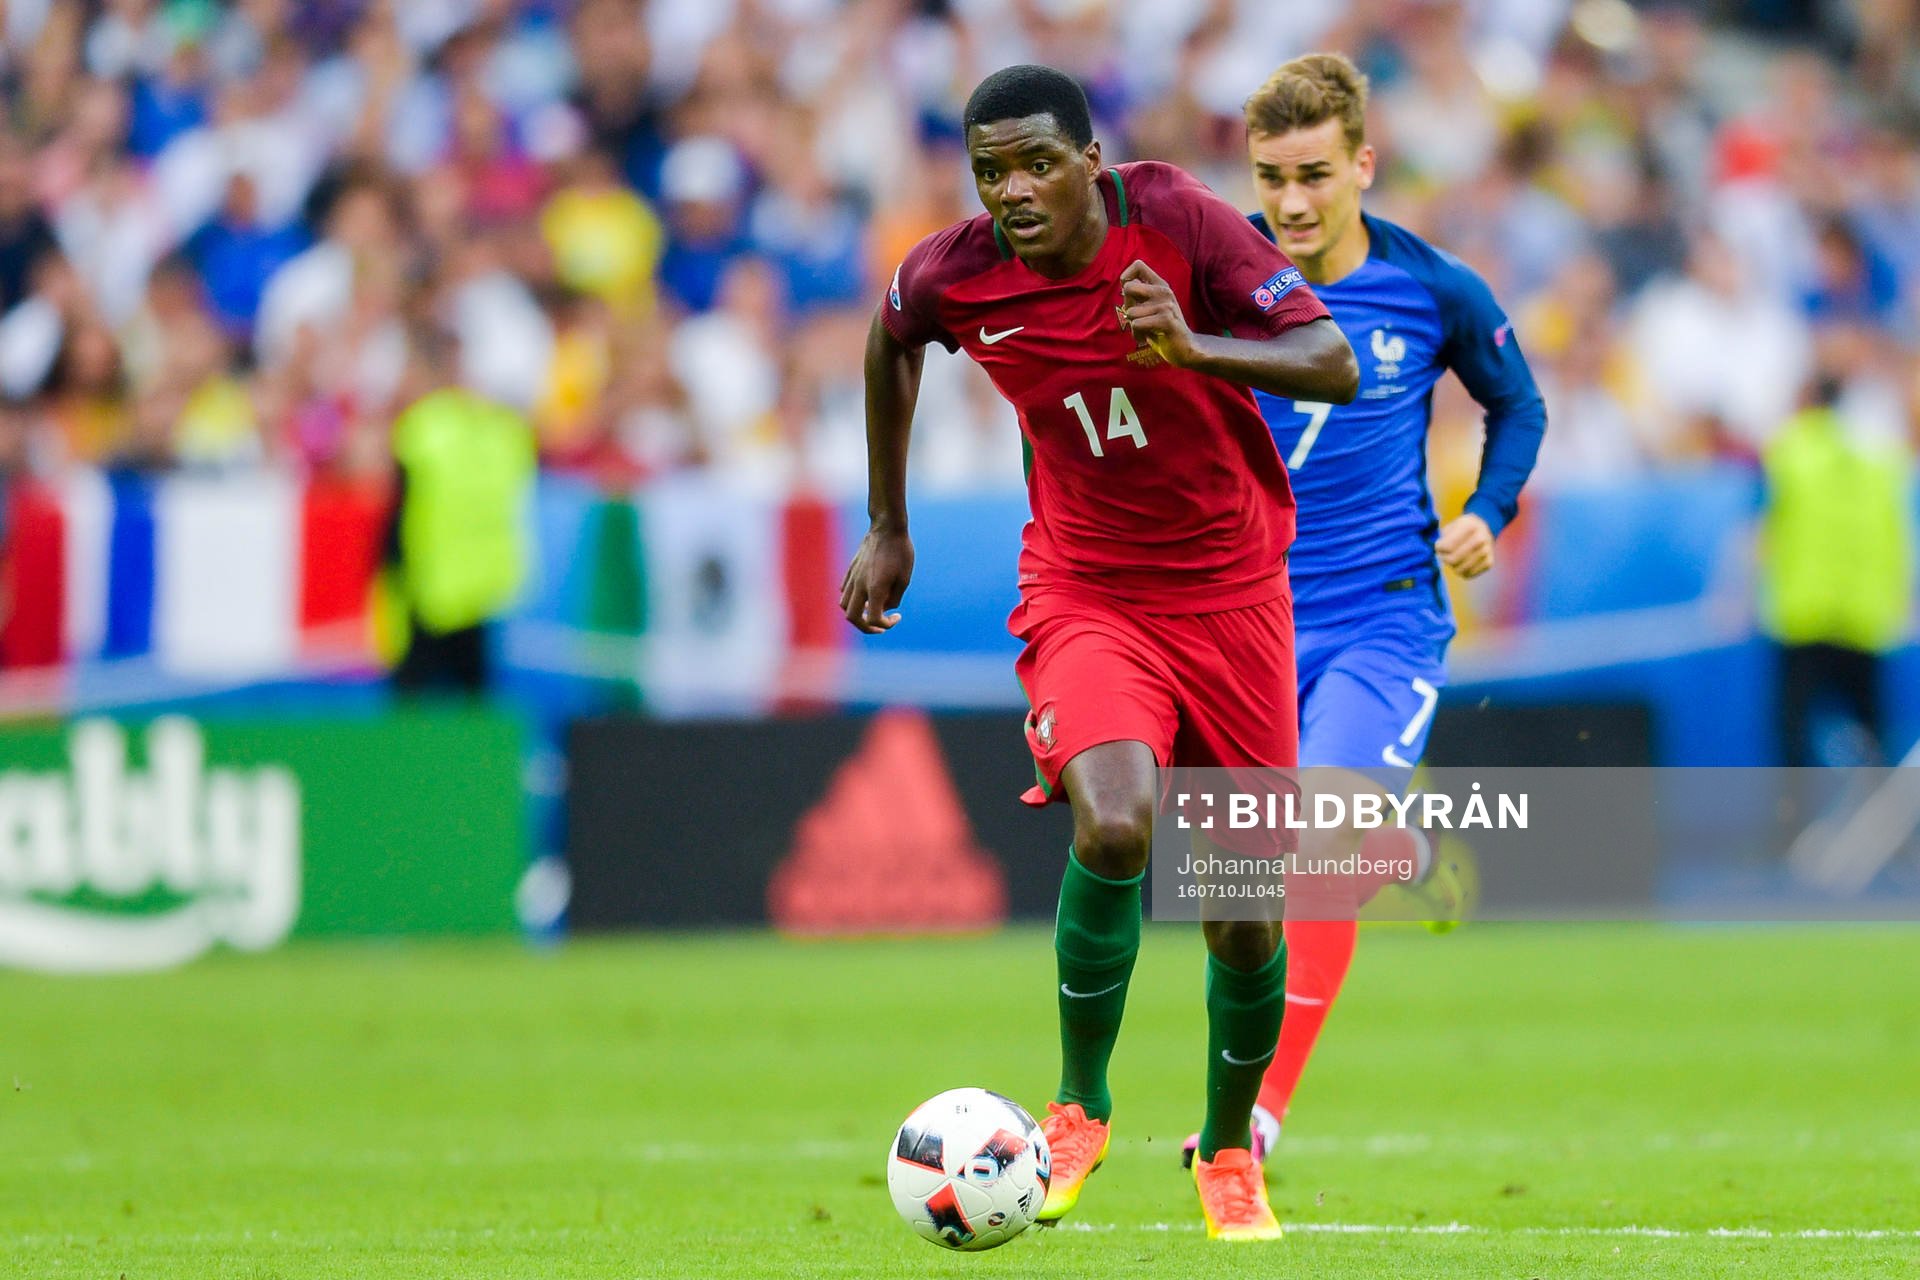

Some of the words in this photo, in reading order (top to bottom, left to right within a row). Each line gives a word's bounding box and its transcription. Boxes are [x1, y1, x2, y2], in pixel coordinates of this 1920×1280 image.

[1063, 387, 1148, 457] 14
[1287, 400, 1332, 470] 7
[1399, 677, 1439, 747] 7
